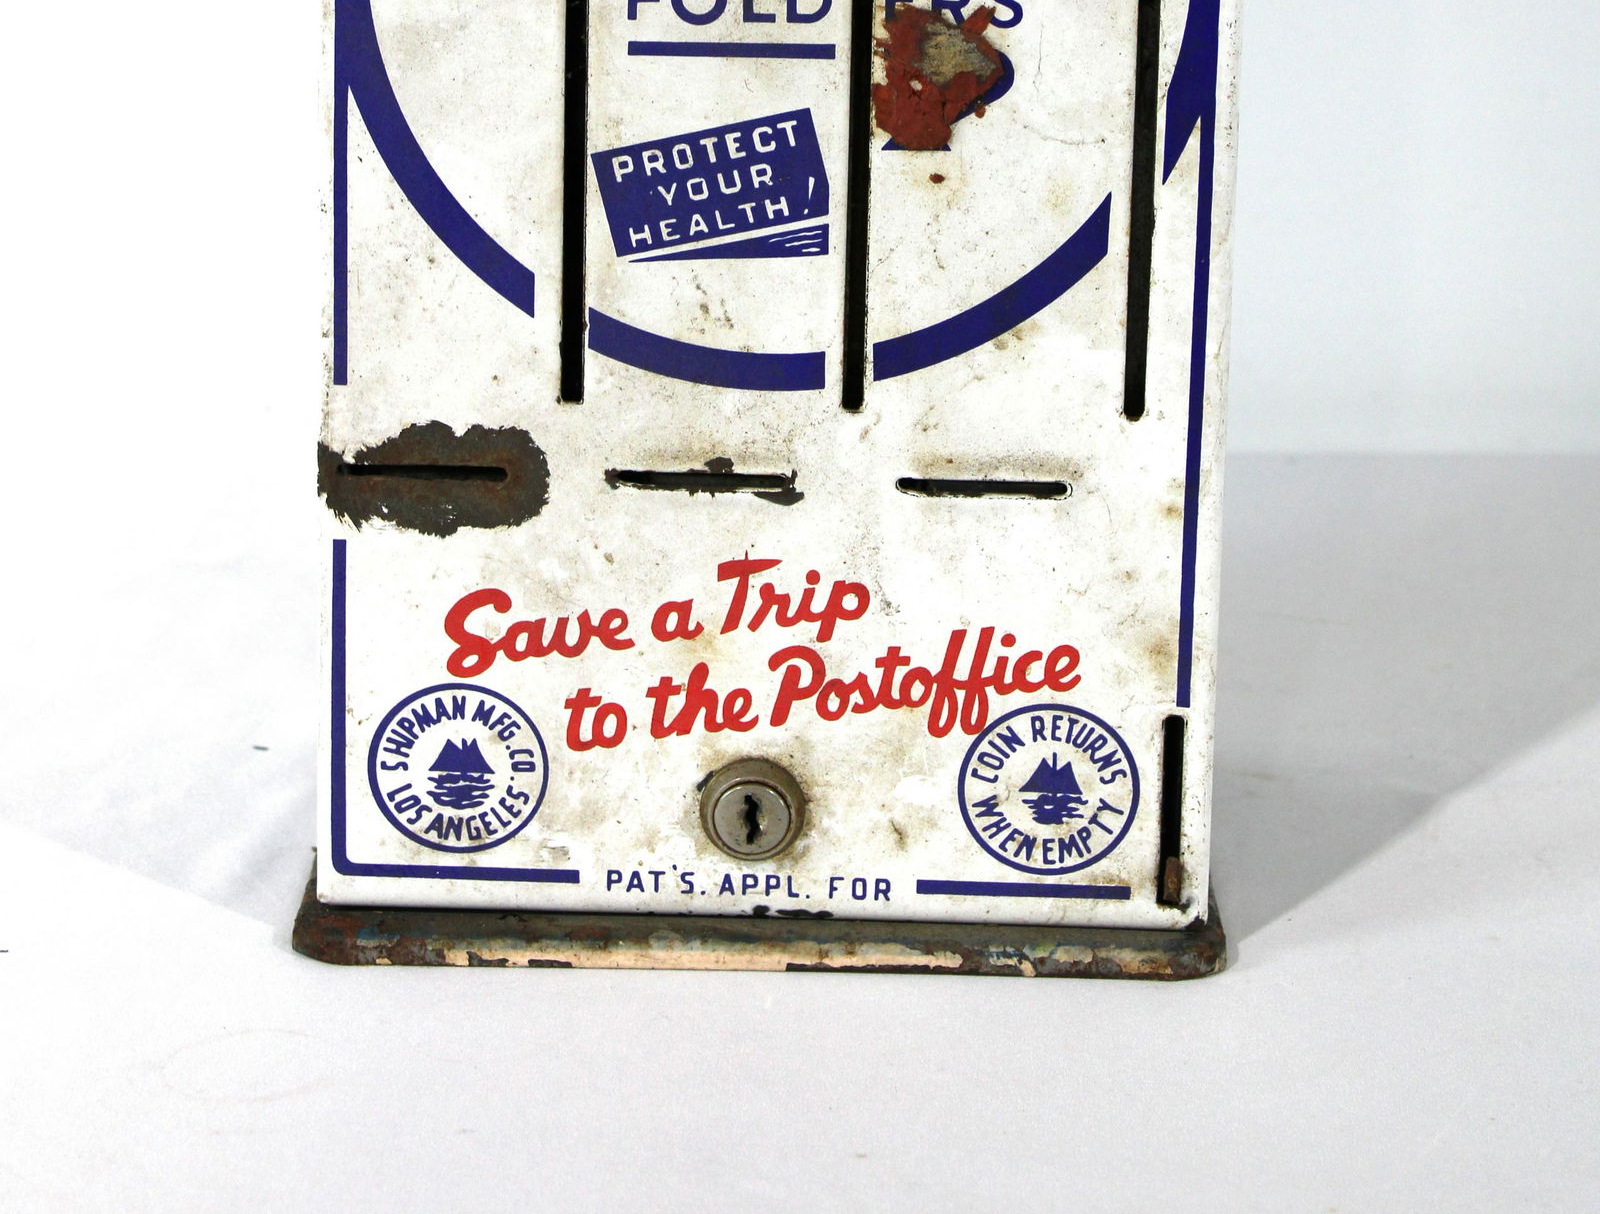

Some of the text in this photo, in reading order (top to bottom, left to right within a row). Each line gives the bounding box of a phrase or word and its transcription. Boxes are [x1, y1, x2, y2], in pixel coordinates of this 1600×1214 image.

[611, 120, 798, 183] PROTECT
[657, 163, 774, 206] YOUR
[628, 176, 816, 248] HEALTH!
[443, 549, 871, 679] Save a Trip
[563, 625, 1083, 752] to the Postoffice
[380, 695, 467, 772] SHIPMAN
[970, 714, 1128, 785] COIN RETURNS
[386, 782, 530, 842] LOS ANGELES
[971, 794, 1125, 865] WHEN EMPTY
[718, 873, 811, 900] APPL.
[828, 876, 892, 902] FOR
